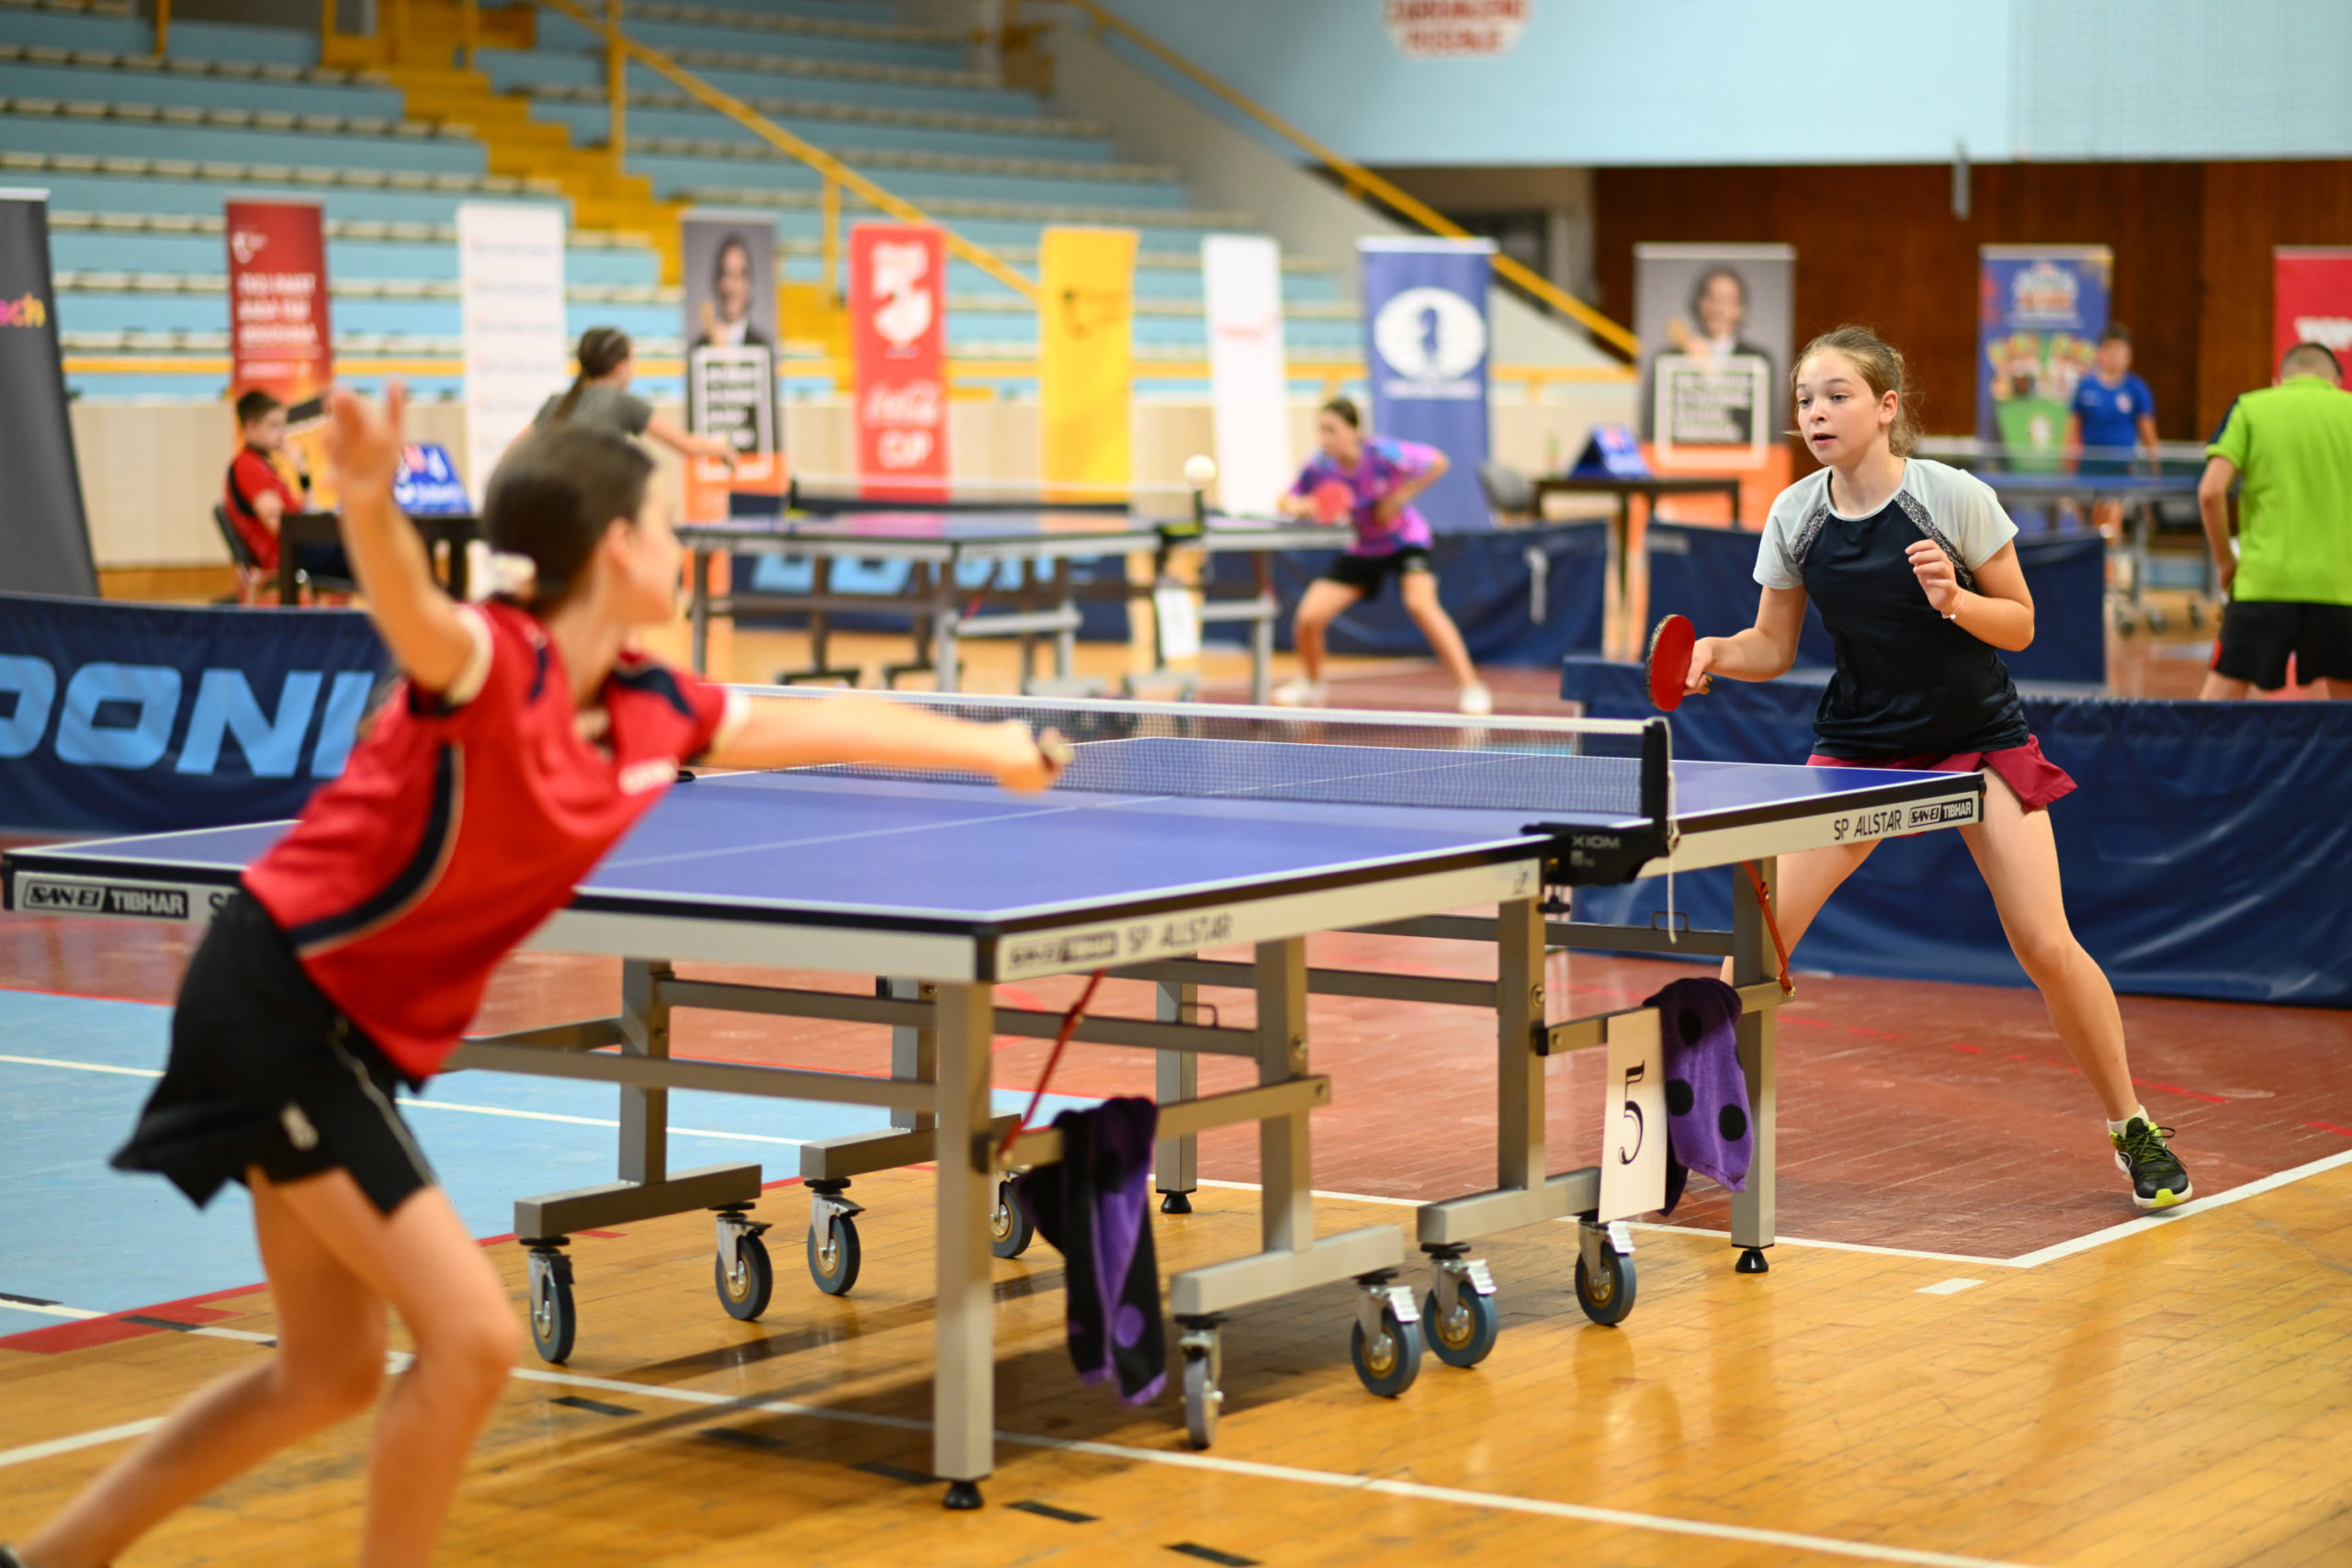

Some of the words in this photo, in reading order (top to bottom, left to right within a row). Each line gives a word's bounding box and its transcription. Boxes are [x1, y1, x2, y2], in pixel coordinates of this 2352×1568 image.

[1834, 818, 1849, 840] SP
[1854, 810, 1901, 838] ALLSTAR
[1943, 801, 1972, 818] TIBHAR
[1572, 836, 1620, 849] XIOM
[109, 890, 185, 915] TIBHAR
[1618, 1059, 1645, 1165] 5
